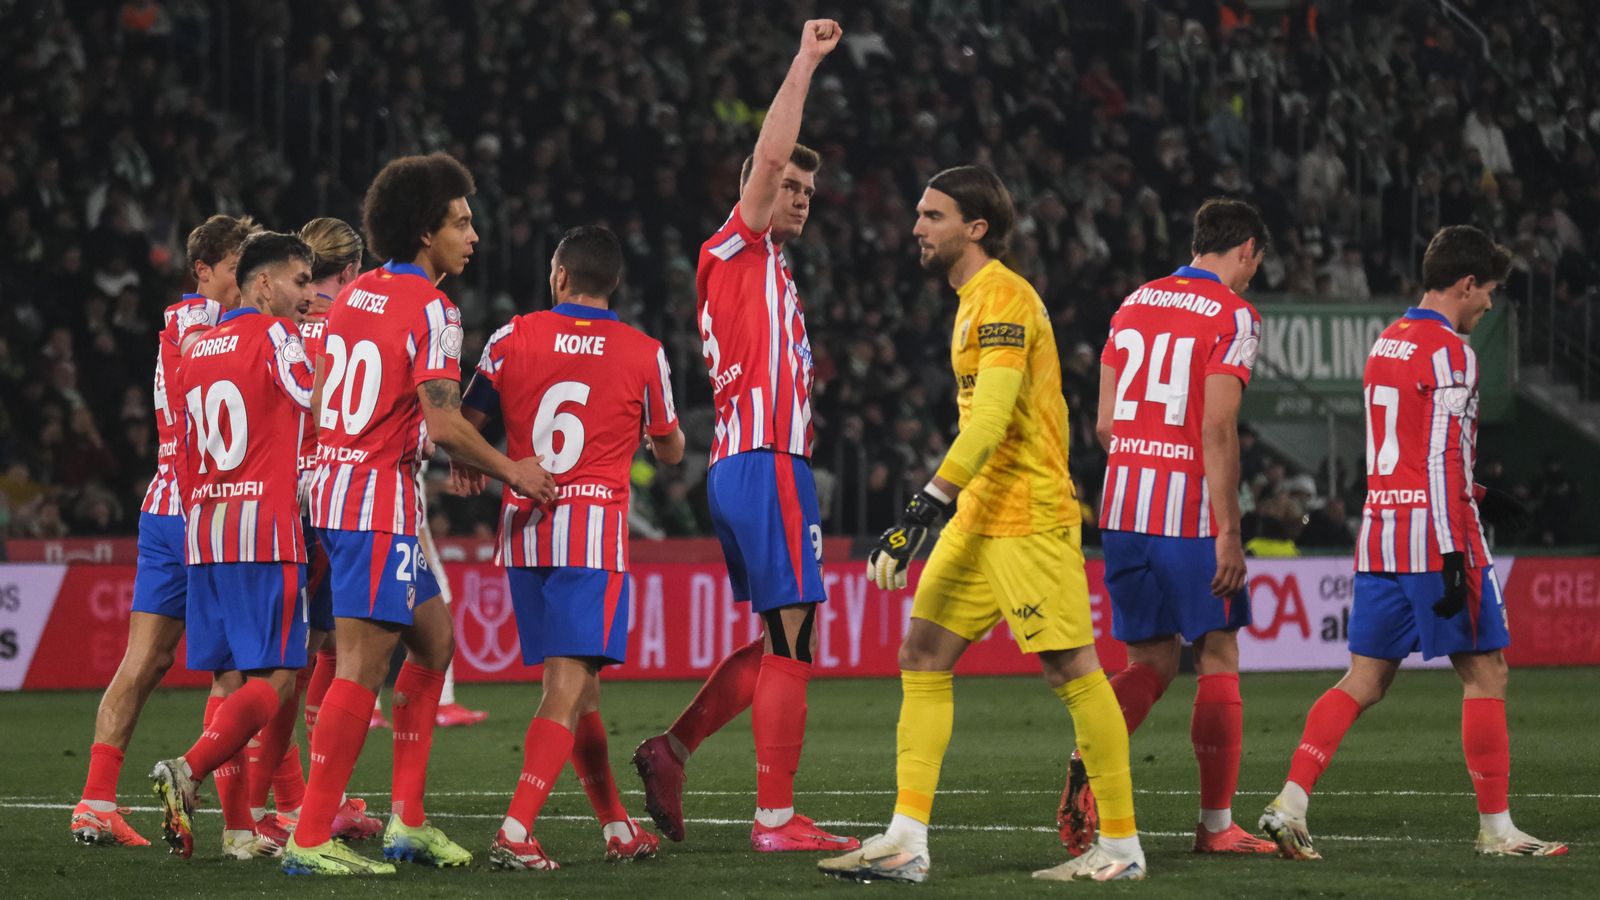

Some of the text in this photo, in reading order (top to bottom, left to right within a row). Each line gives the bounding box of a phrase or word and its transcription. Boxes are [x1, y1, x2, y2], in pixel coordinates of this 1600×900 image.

[346, 288, 389, 314] WITSEL
[1138, 287, 1223, 318] NORMAND
[300, 322, 325, 339] ER
[553, 332, 606, 357] KOKE
[319, 333, 383, 436] 20
[1112, 328, 1197, 428] 24
[184, 379, 248, 475] 10
[531, 380, 591, 475] 6
[1363, 383, 1401, 477] 17
[1120, 437, 1194, 461] HYUNDAI
[808, 523, 823, 561] 9
[1532, 571, 1600, 609] CRE
